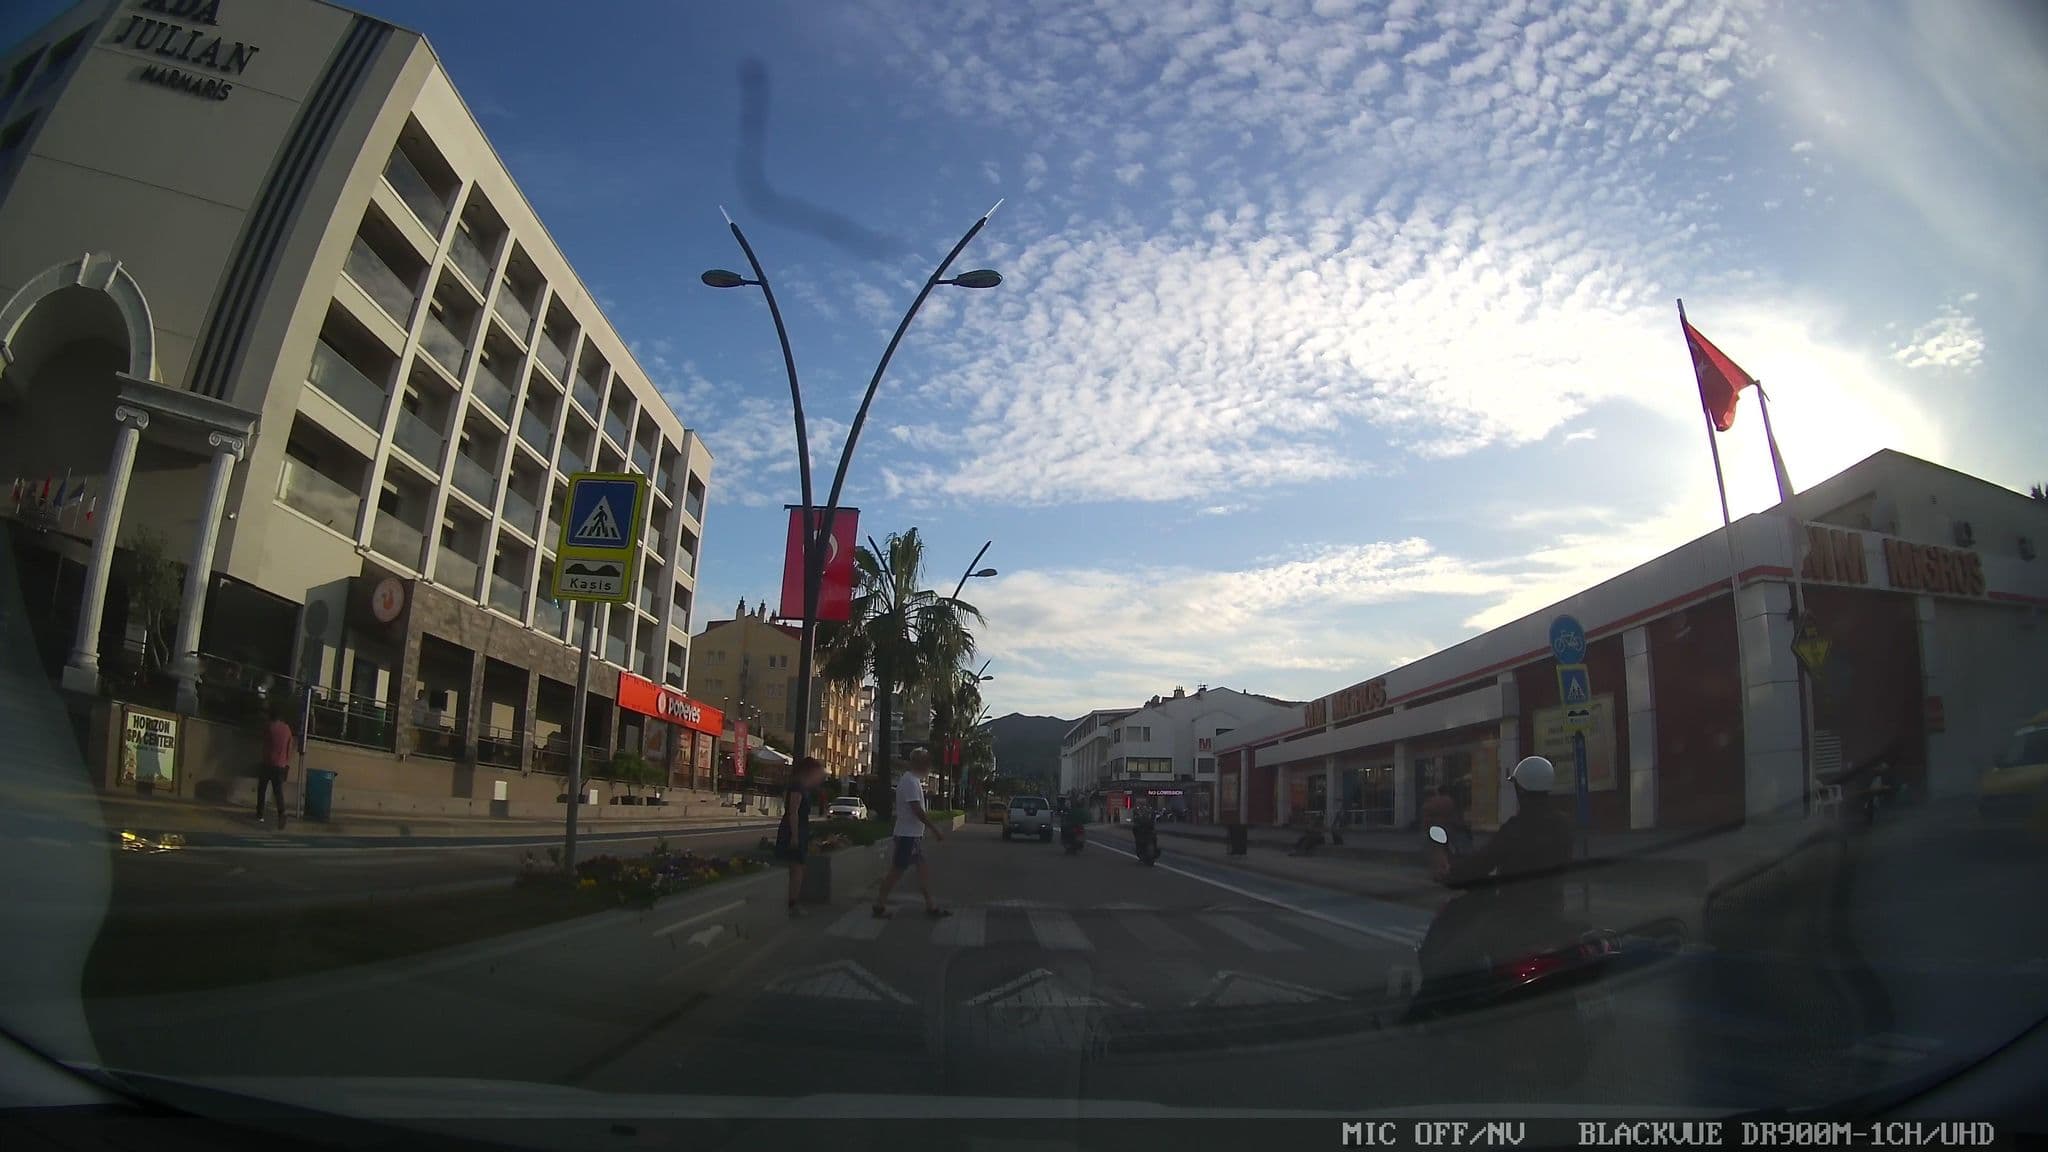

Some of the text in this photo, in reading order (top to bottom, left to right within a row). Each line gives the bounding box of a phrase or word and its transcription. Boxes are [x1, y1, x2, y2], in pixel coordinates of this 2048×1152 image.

[113, 15, 260, 75] JULIAN
[570, 578, 612, 591] Kasis
[133, 715, 170, 734] HORIZON
[127, 729, 141, 744] SPA
[143, 731, 174, 749] CENTER
